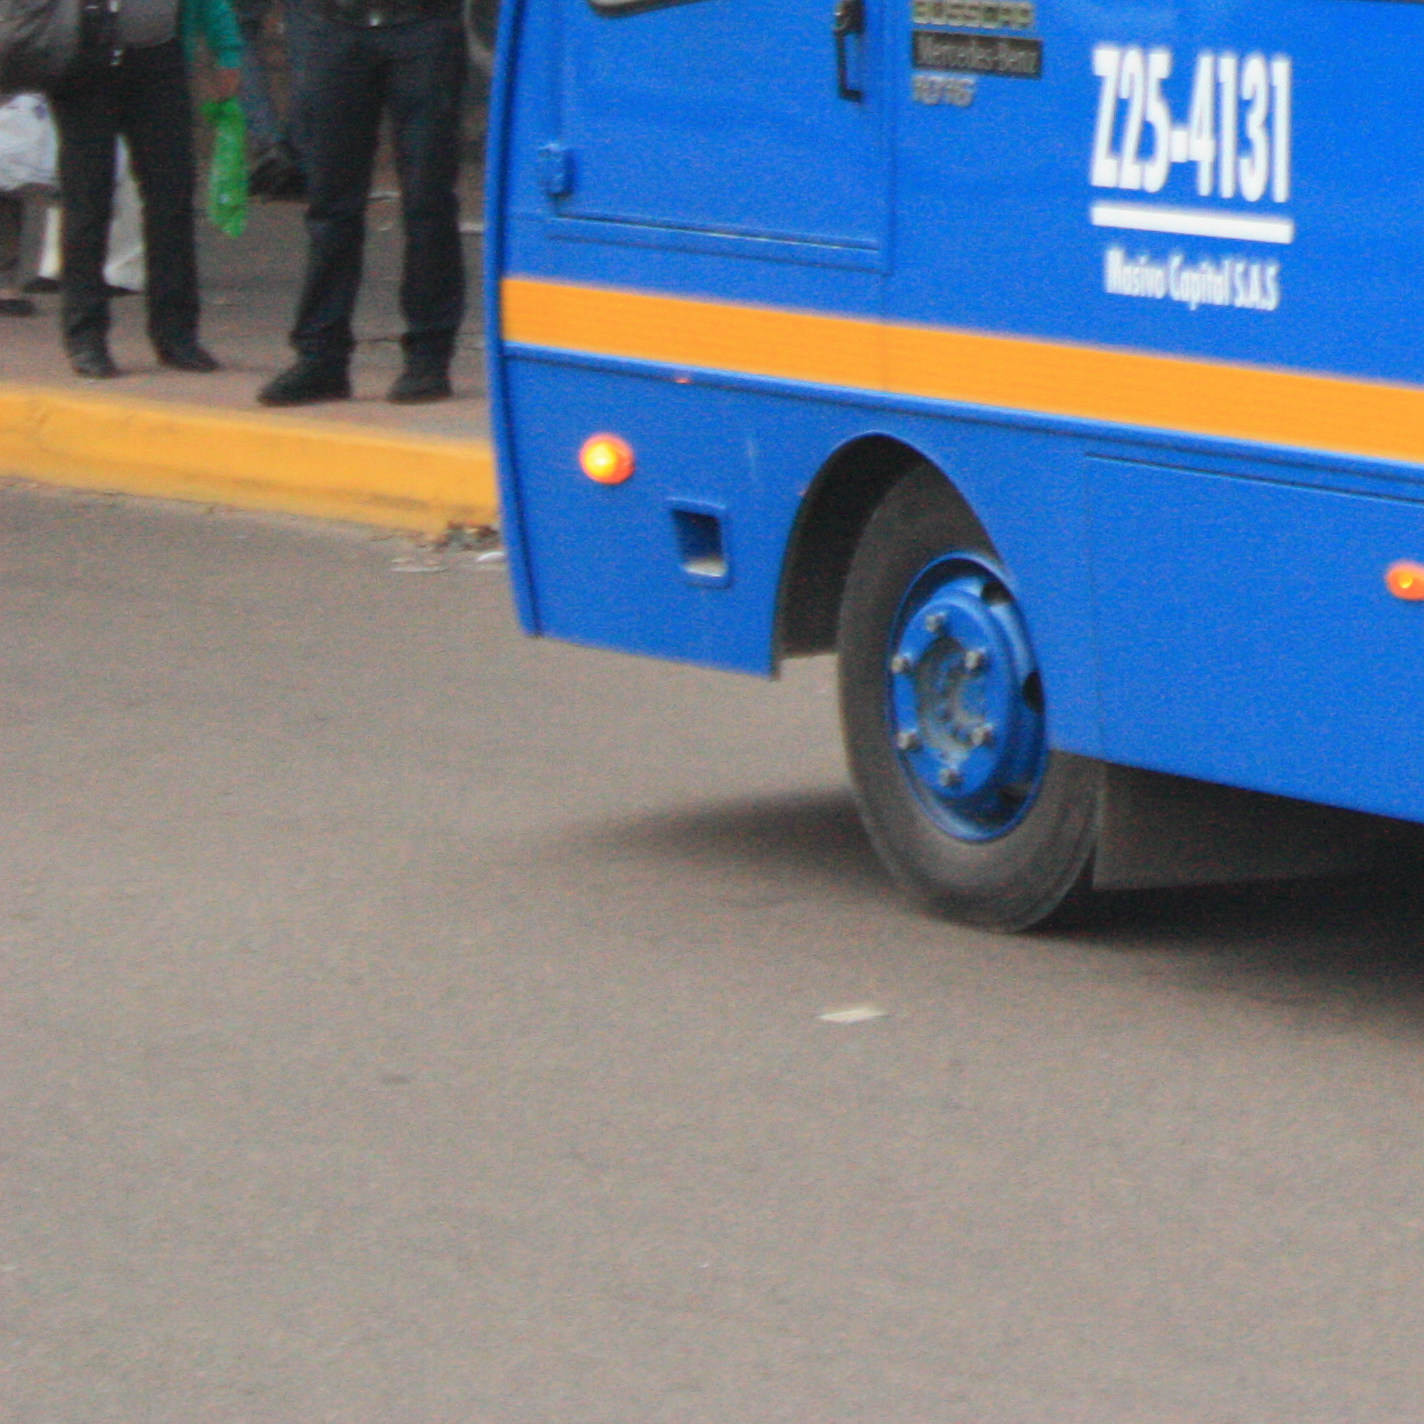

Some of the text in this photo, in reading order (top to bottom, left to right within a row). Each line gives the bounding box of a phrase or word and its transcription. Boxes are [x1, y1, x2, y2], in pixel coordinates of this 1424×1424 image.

[1091, 43, 1291, 203] Z25-4131
[1107, 247, 1166, 299] Masivo
[1169, 252, 1231, 311] Capital
